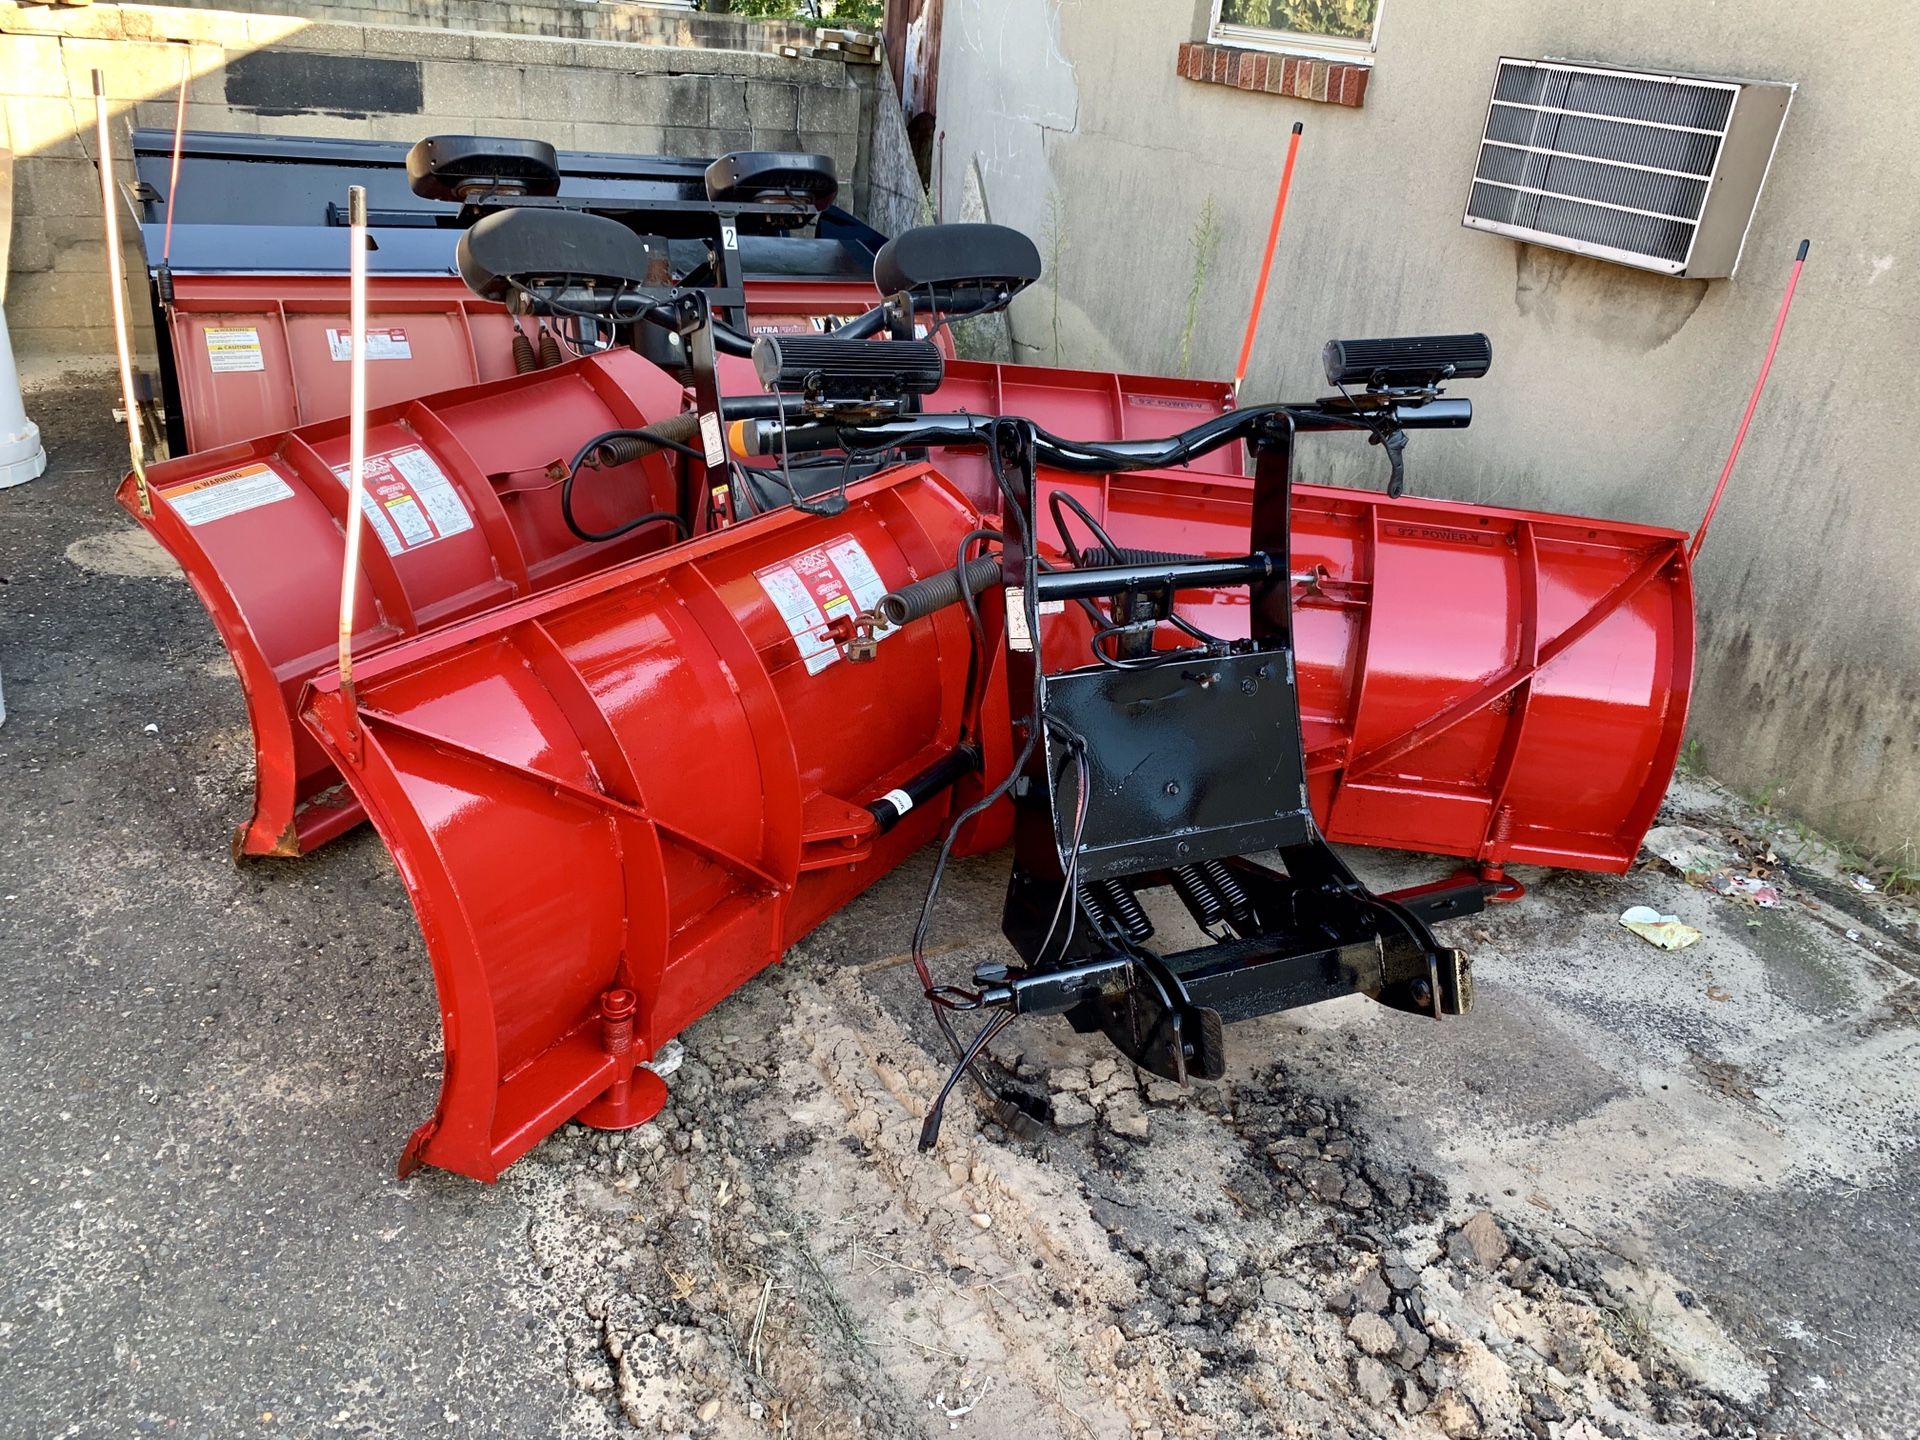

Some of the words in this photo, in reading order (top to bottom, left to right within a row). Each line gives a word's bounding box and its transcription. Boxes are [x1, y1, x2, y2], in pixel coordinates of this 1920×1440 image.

[726, 229, 735, 247] 2
[753, 326, 779, 334] ULTRA
[200, 472, 243, 489] WARNING
[1421, 529, 1479, 545] POWER-V
[799, 551, 828, 570] BOSS
